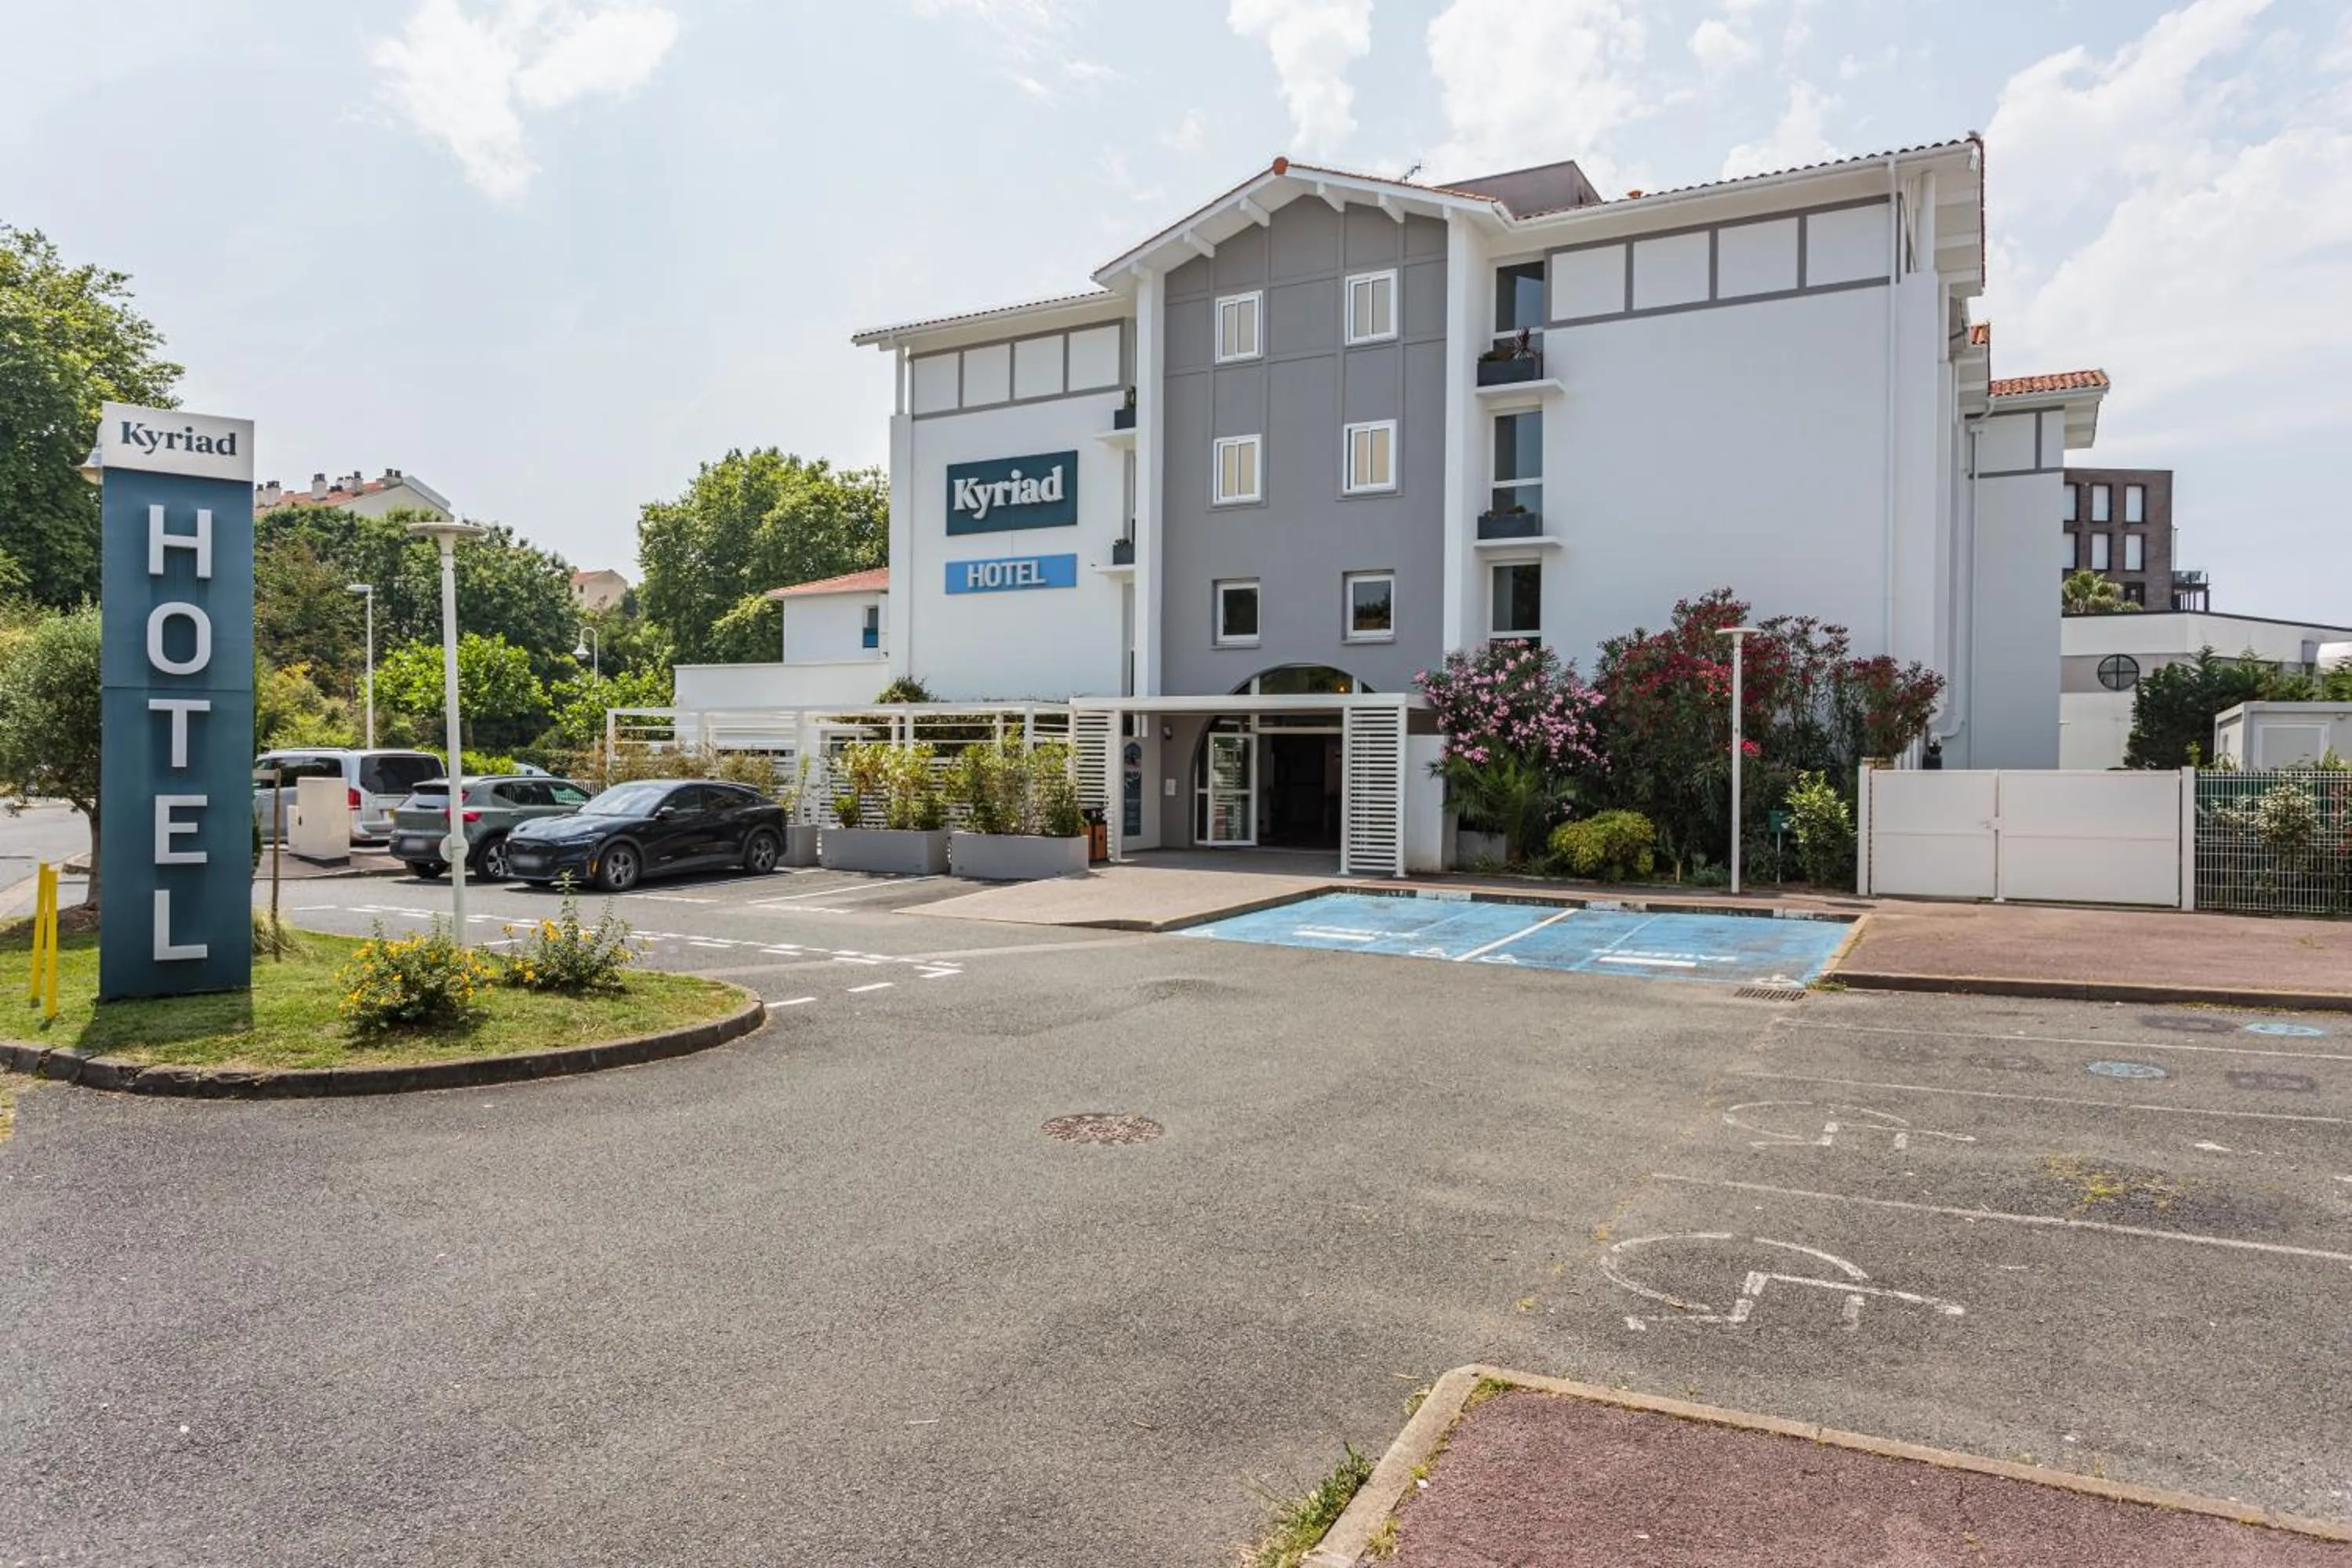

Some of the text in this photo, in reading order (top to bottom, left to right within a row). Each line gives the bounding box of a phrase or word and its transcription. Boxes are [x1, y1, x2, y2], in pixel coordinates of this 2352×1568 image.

[121, 421, 237, 456] Kyriad
[953, 465, 1065, 520] Kyriad
[967, 560, 1047, 587] HOTEL
[147, 504, 212, 961] HOTEL
